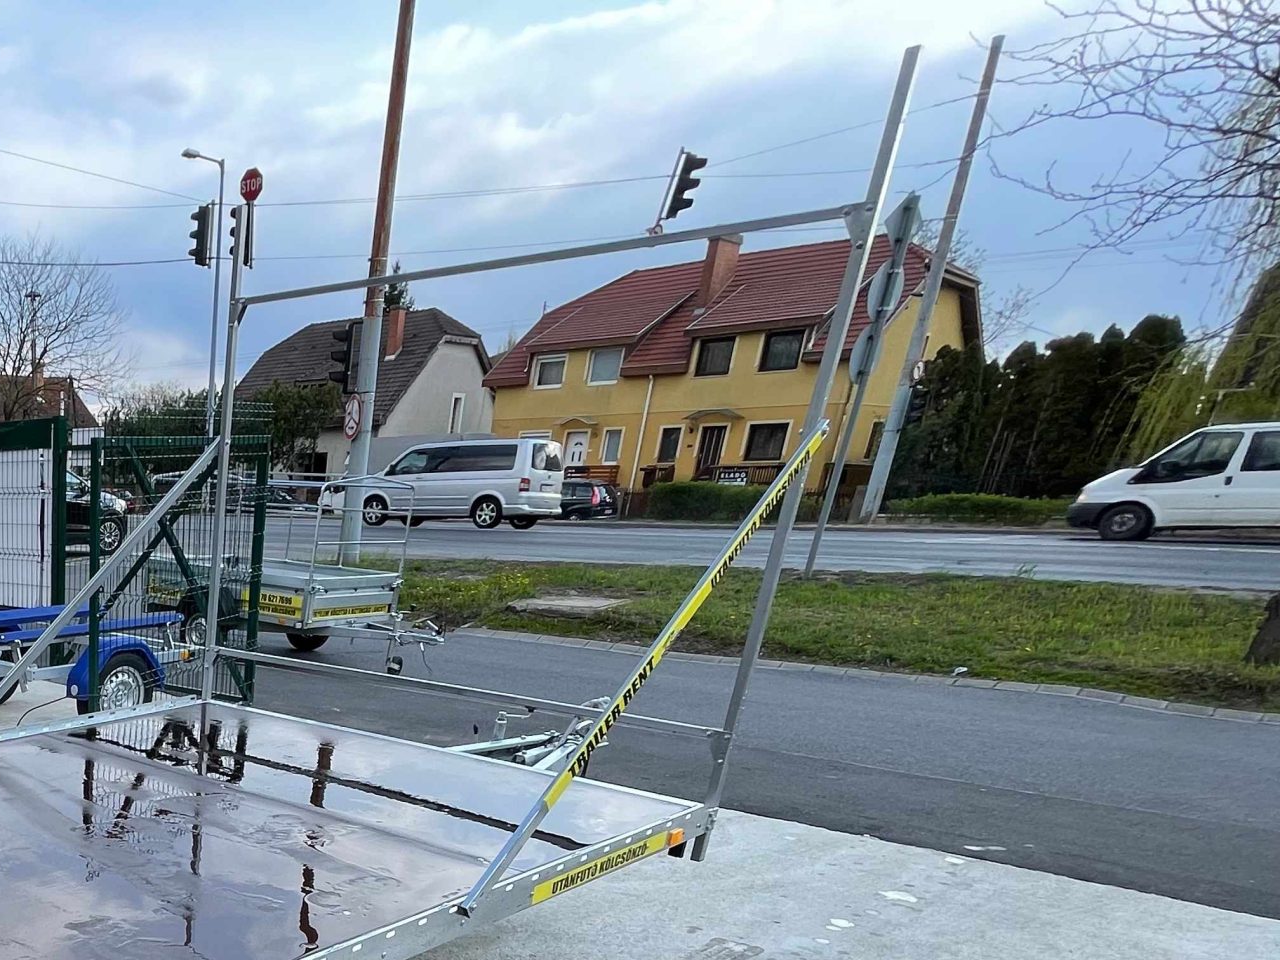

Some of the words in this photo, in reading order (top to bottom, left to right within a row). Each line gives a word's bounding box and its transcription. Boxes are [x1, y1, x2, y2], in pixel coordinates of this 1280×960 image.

[241, 177, 262, 194] STOP
[568, 702, 621, 778] TRAILER
[622, 655, 655, 706] RENT
[551, 861, 597, 894] UTÁNFUTÓ
